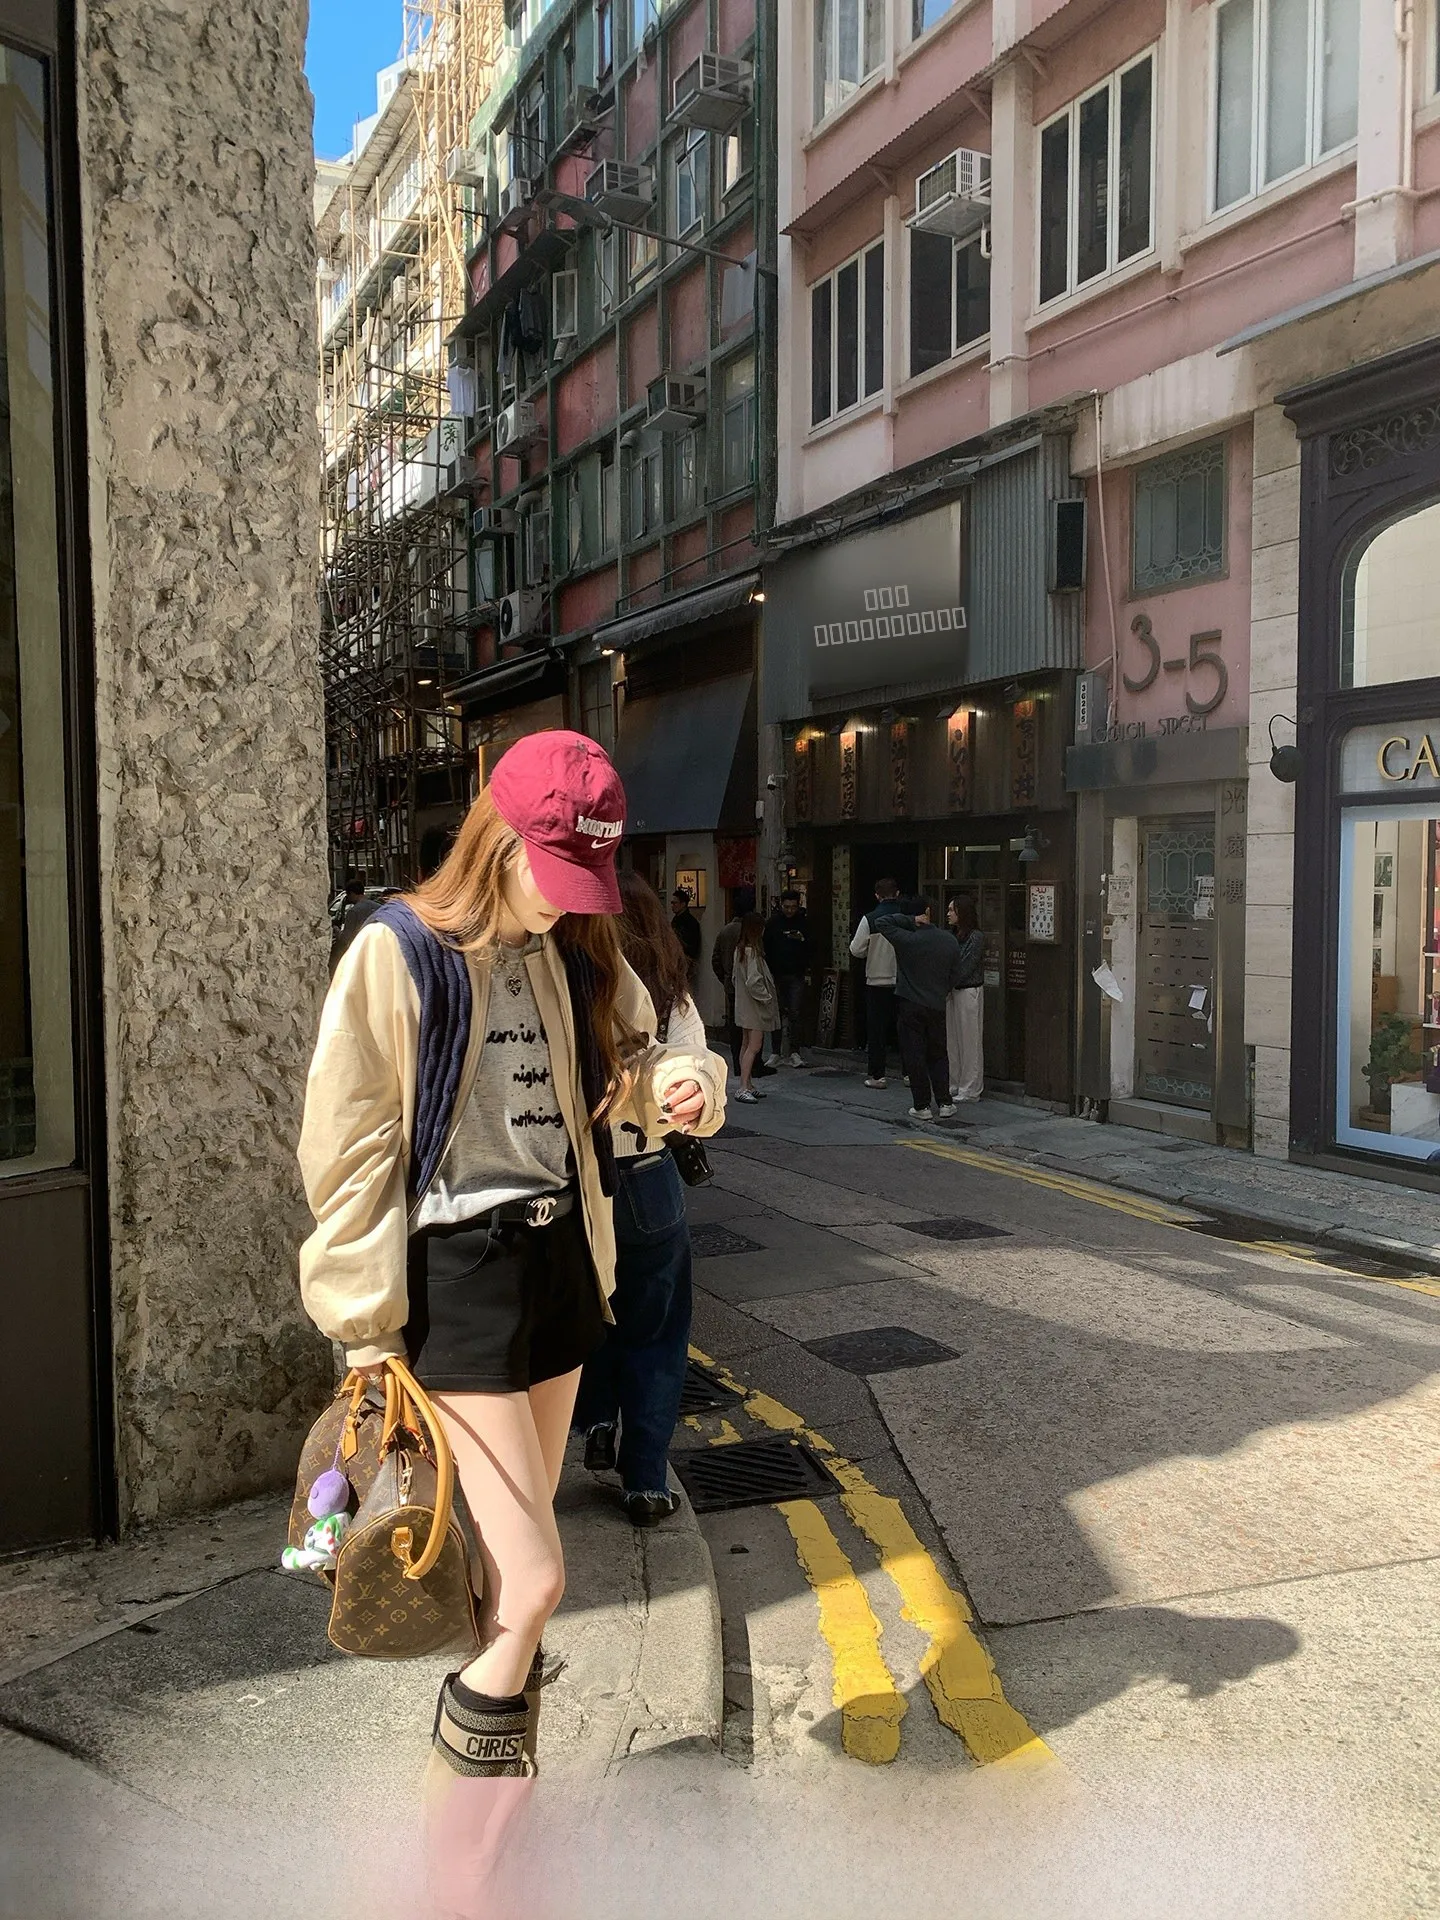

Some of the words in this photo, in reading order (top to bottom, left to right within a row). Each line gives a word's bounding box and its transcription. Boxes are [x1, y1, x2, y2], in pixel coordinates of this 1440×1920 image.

[1123, 613, 1229, 715] 3-5
[1376, 734, 1440, 781] CA
[513, 1064, 550, 1088] night
[511, 1106, 564, 1129] nothing
